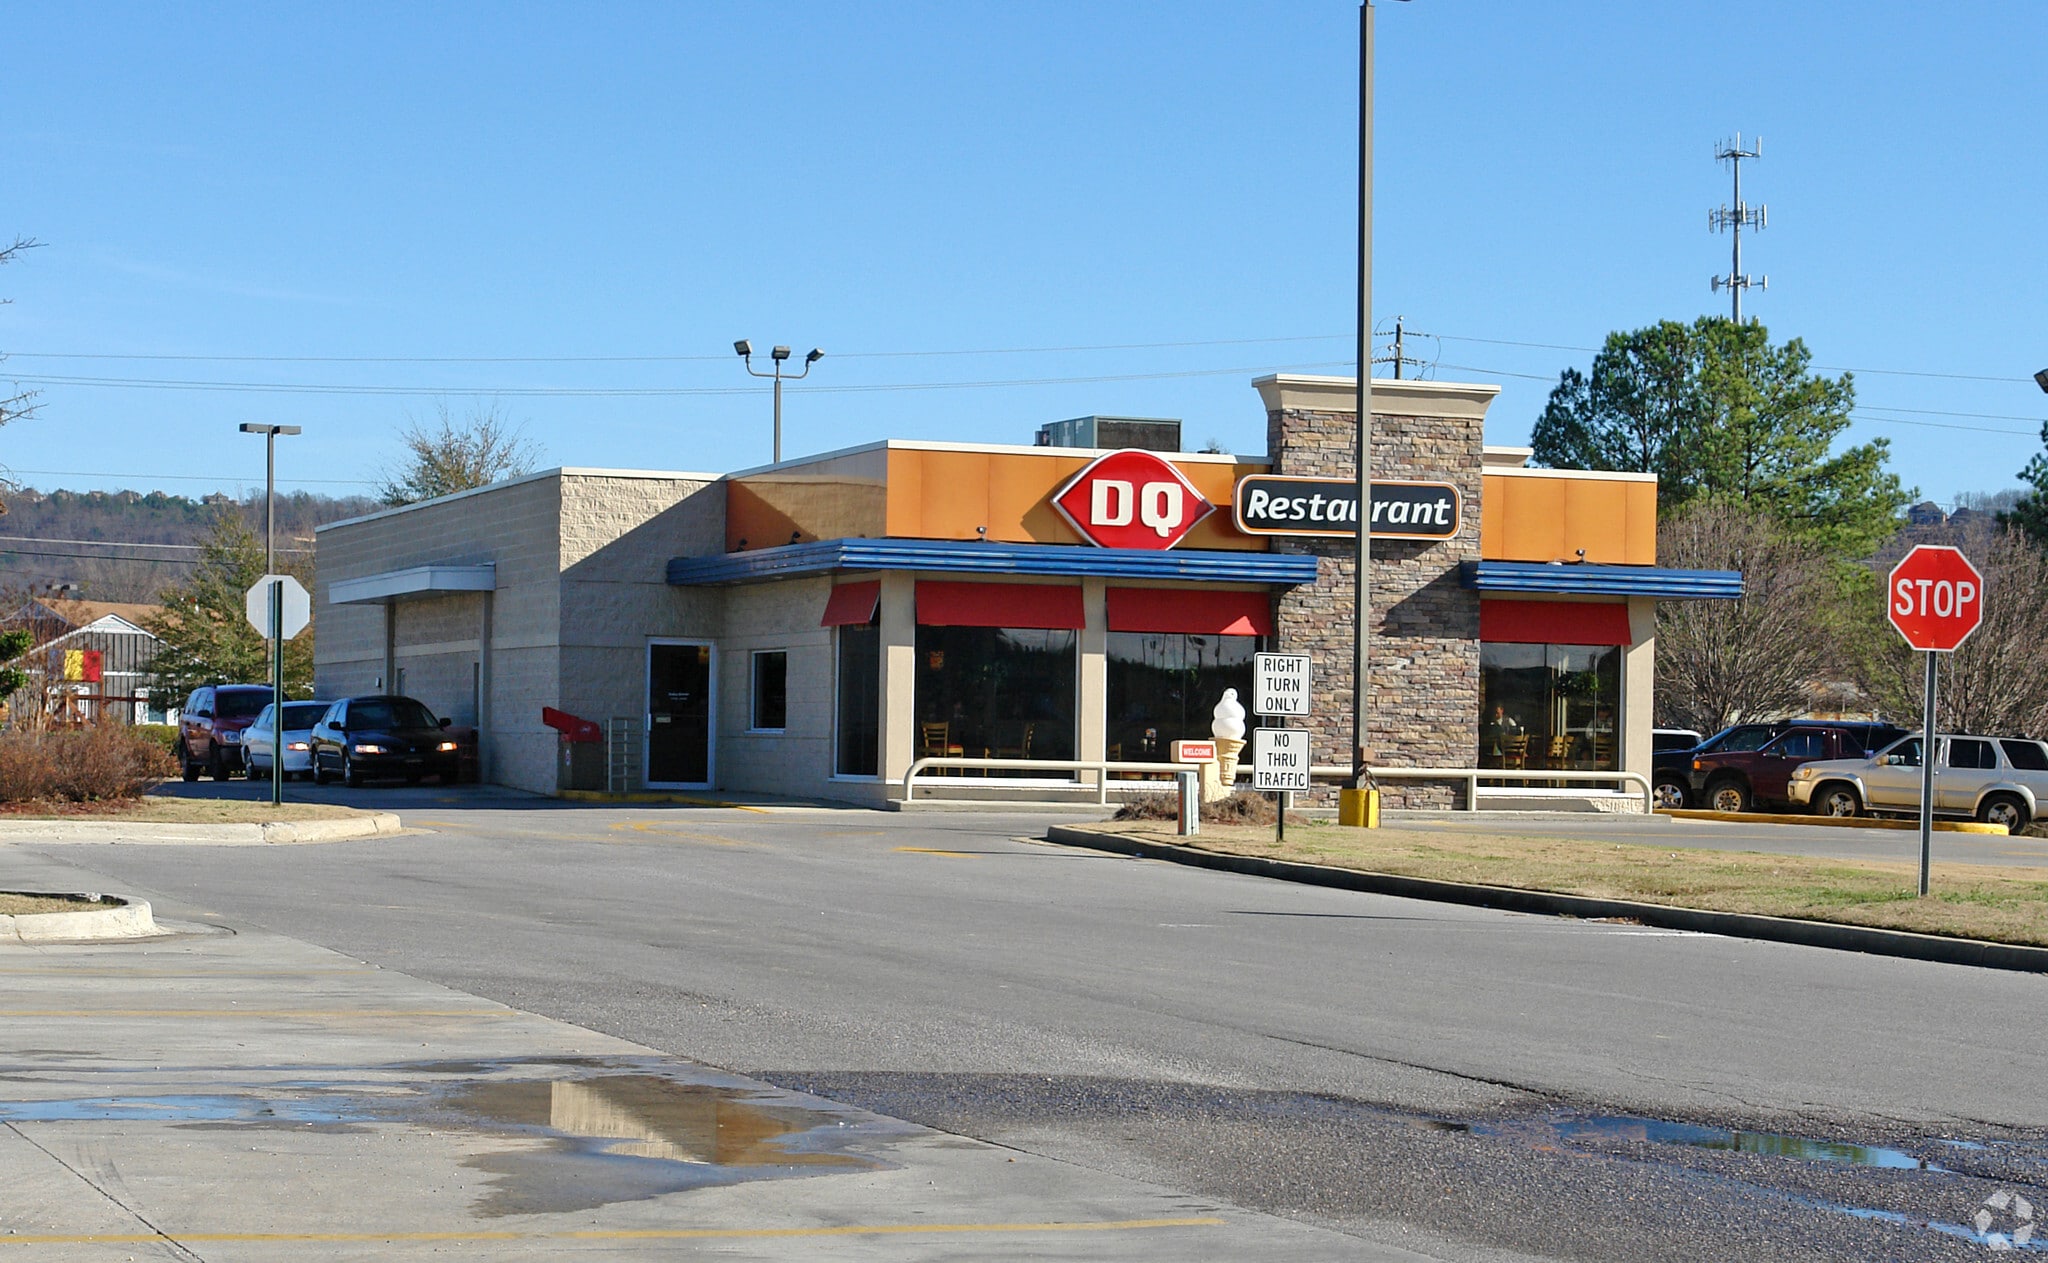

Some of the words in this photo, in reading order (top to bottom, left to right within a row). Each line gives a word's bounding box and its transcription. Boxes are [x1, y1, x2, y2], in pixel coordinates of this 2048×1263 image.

[1091, 479, 1183, 538] DQ
[1895, 578, 1976, 618] STOP
[1264, 658, 1303, 673] RIGHT
[1266, 677, 1300, 692] TURN
[1265, 697, 1299, 712] ONLY
[1274, 733, 1290, 747] NO
[1183, 748, 1211, 756] WELCOME
[1267, 752, 1297, 768] THRU
[1258, 772, 1306, 787] TRAFFIC
